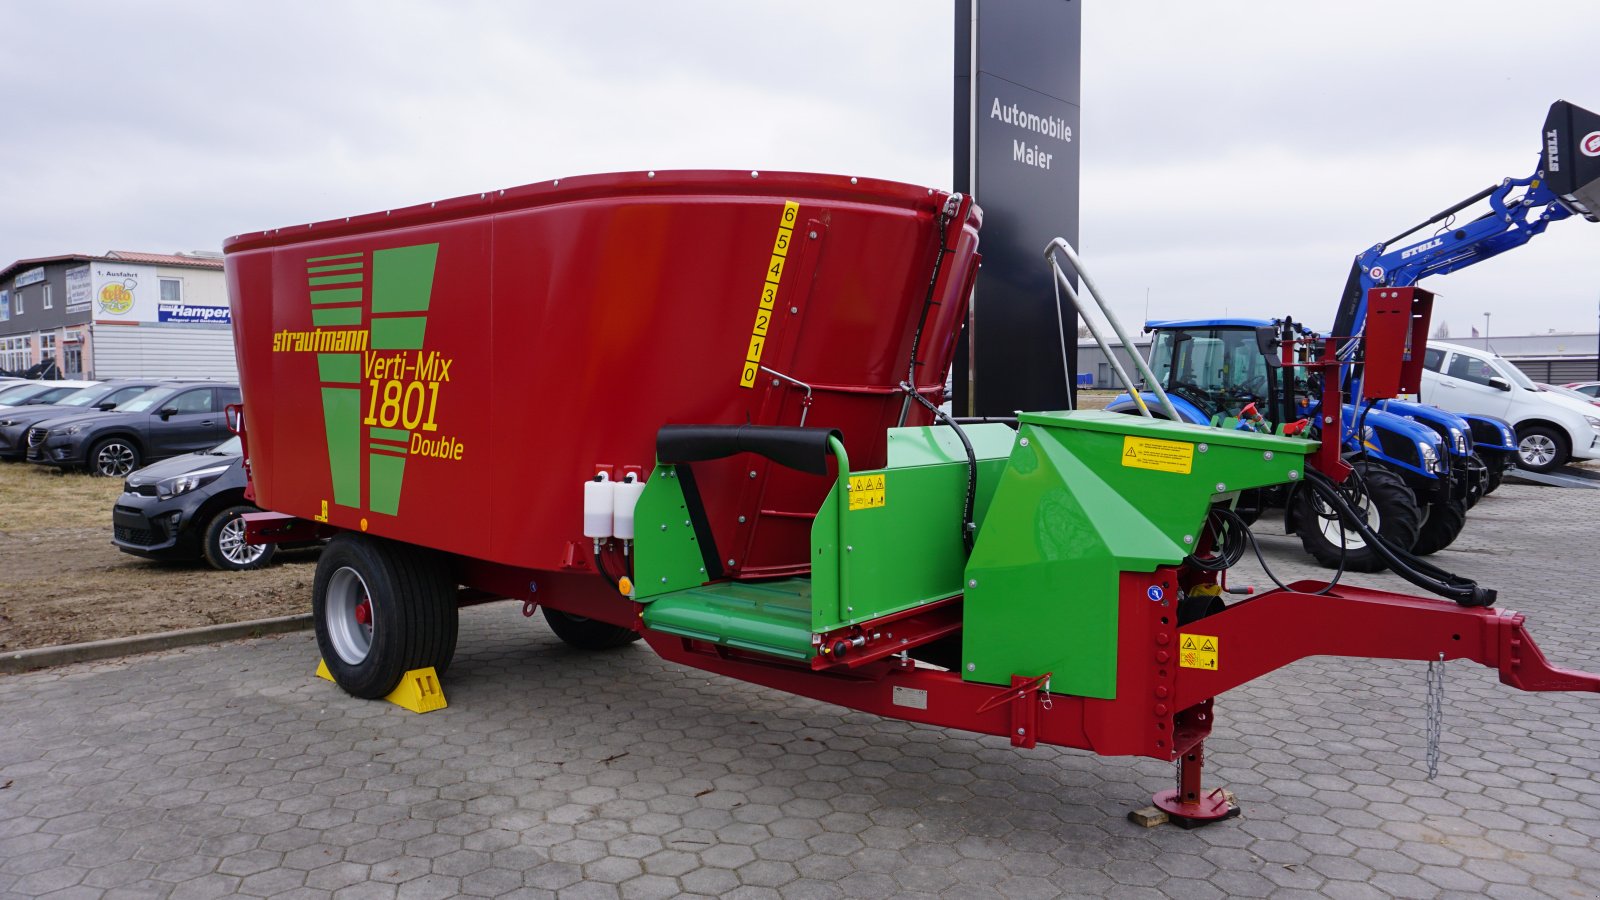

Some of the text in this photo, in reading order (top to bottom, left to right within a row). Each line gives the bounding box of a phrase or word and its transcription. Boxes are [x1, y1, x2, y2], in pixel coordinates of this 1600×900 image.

[990, 97, 1072, 143] Automobile
[1013, 139, 1053, 170] Maier
[1547, 129, 1560, 172] STOLL
[784, 207, 796, 222] 6
[777, 234, 788, 249] 5
[1401, 238, 1444, 260] STOLL
[770, 263, 781, 277] 4
[763, 289, 774, 303] 3
[756, 315, 768, 330] 2
[272, 327, 369, 352] strautmann
[753, 342, 760, 356] 1
[364, 350, 452, 382] Verti-Mix
[744, 367, 755, 382] 0
[364, 379, 440, 432] 1801
[410, 432, 464, 461] Double
